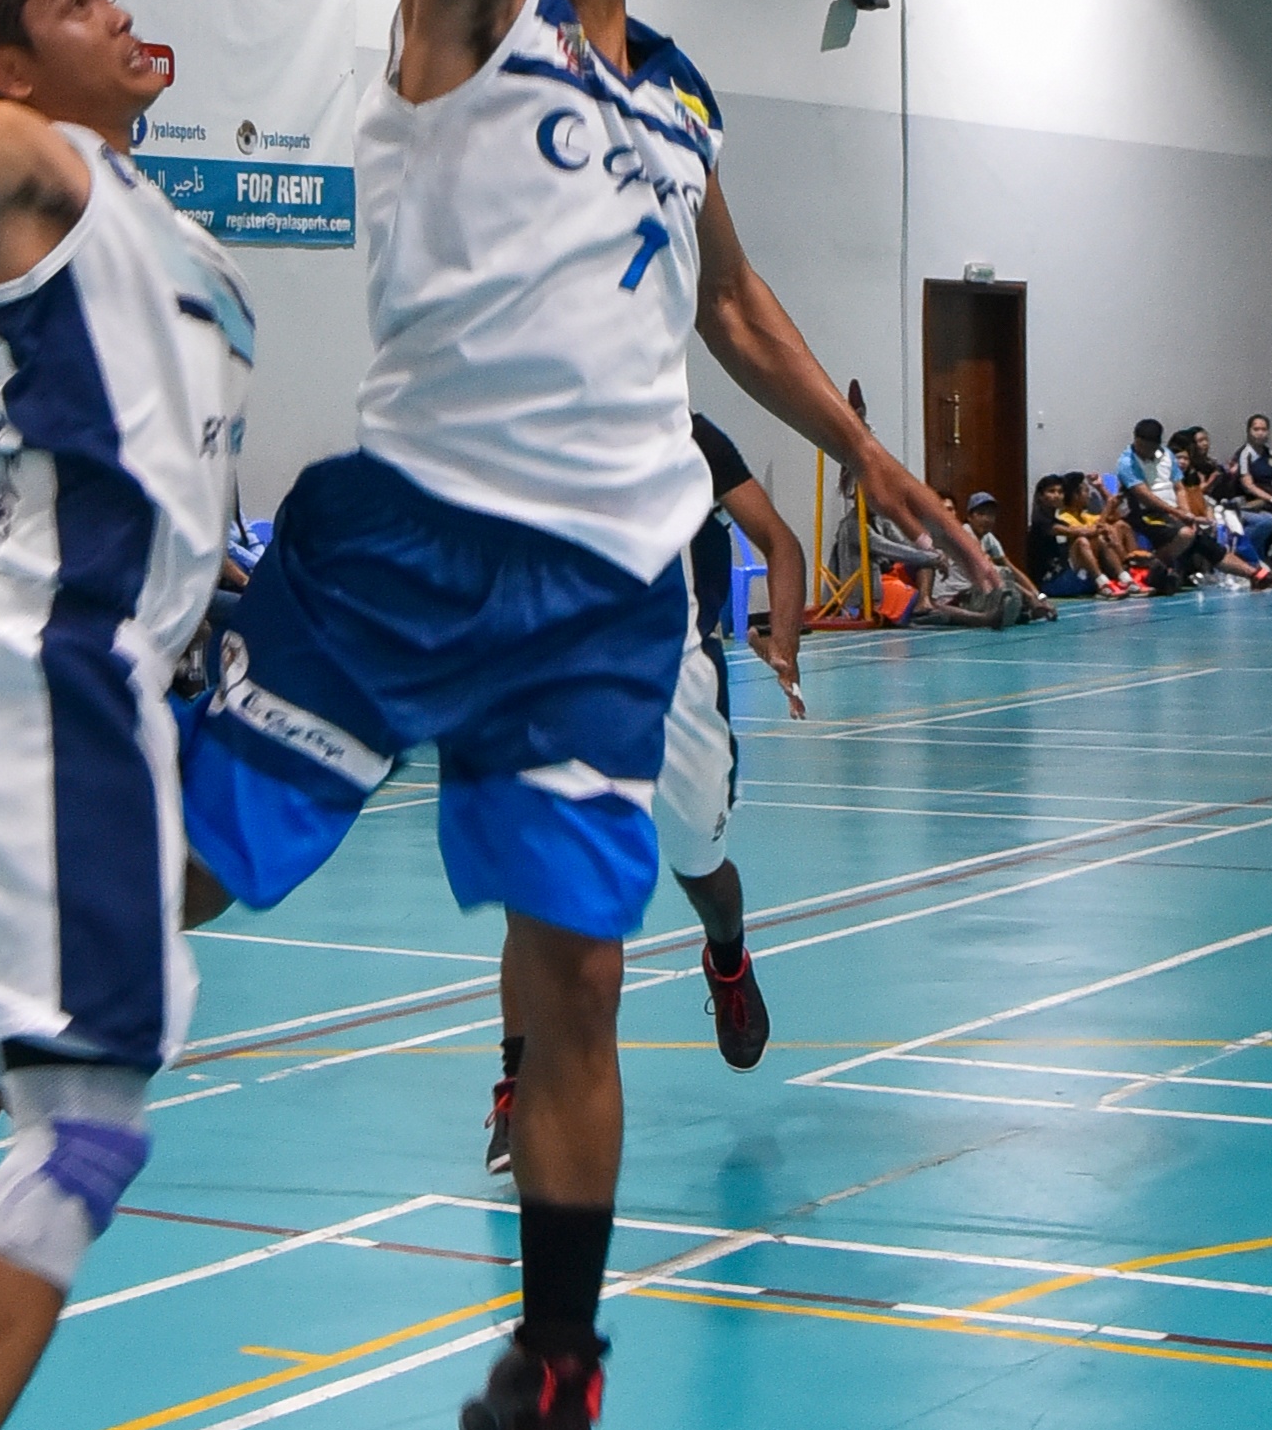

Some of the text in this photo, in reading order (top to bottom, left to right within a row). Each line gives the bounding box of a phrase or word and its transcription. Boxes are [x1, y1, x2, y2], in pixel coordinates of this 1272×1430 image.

[150, 121, 207, 142] /yalasports
[260, 131, 311, 151] /yalasports
[170, 165, 204, 197] تأجير
[237, 172, 324, 205] FOR RENT
[226, 212, 351, 234] register@yalasports.com
